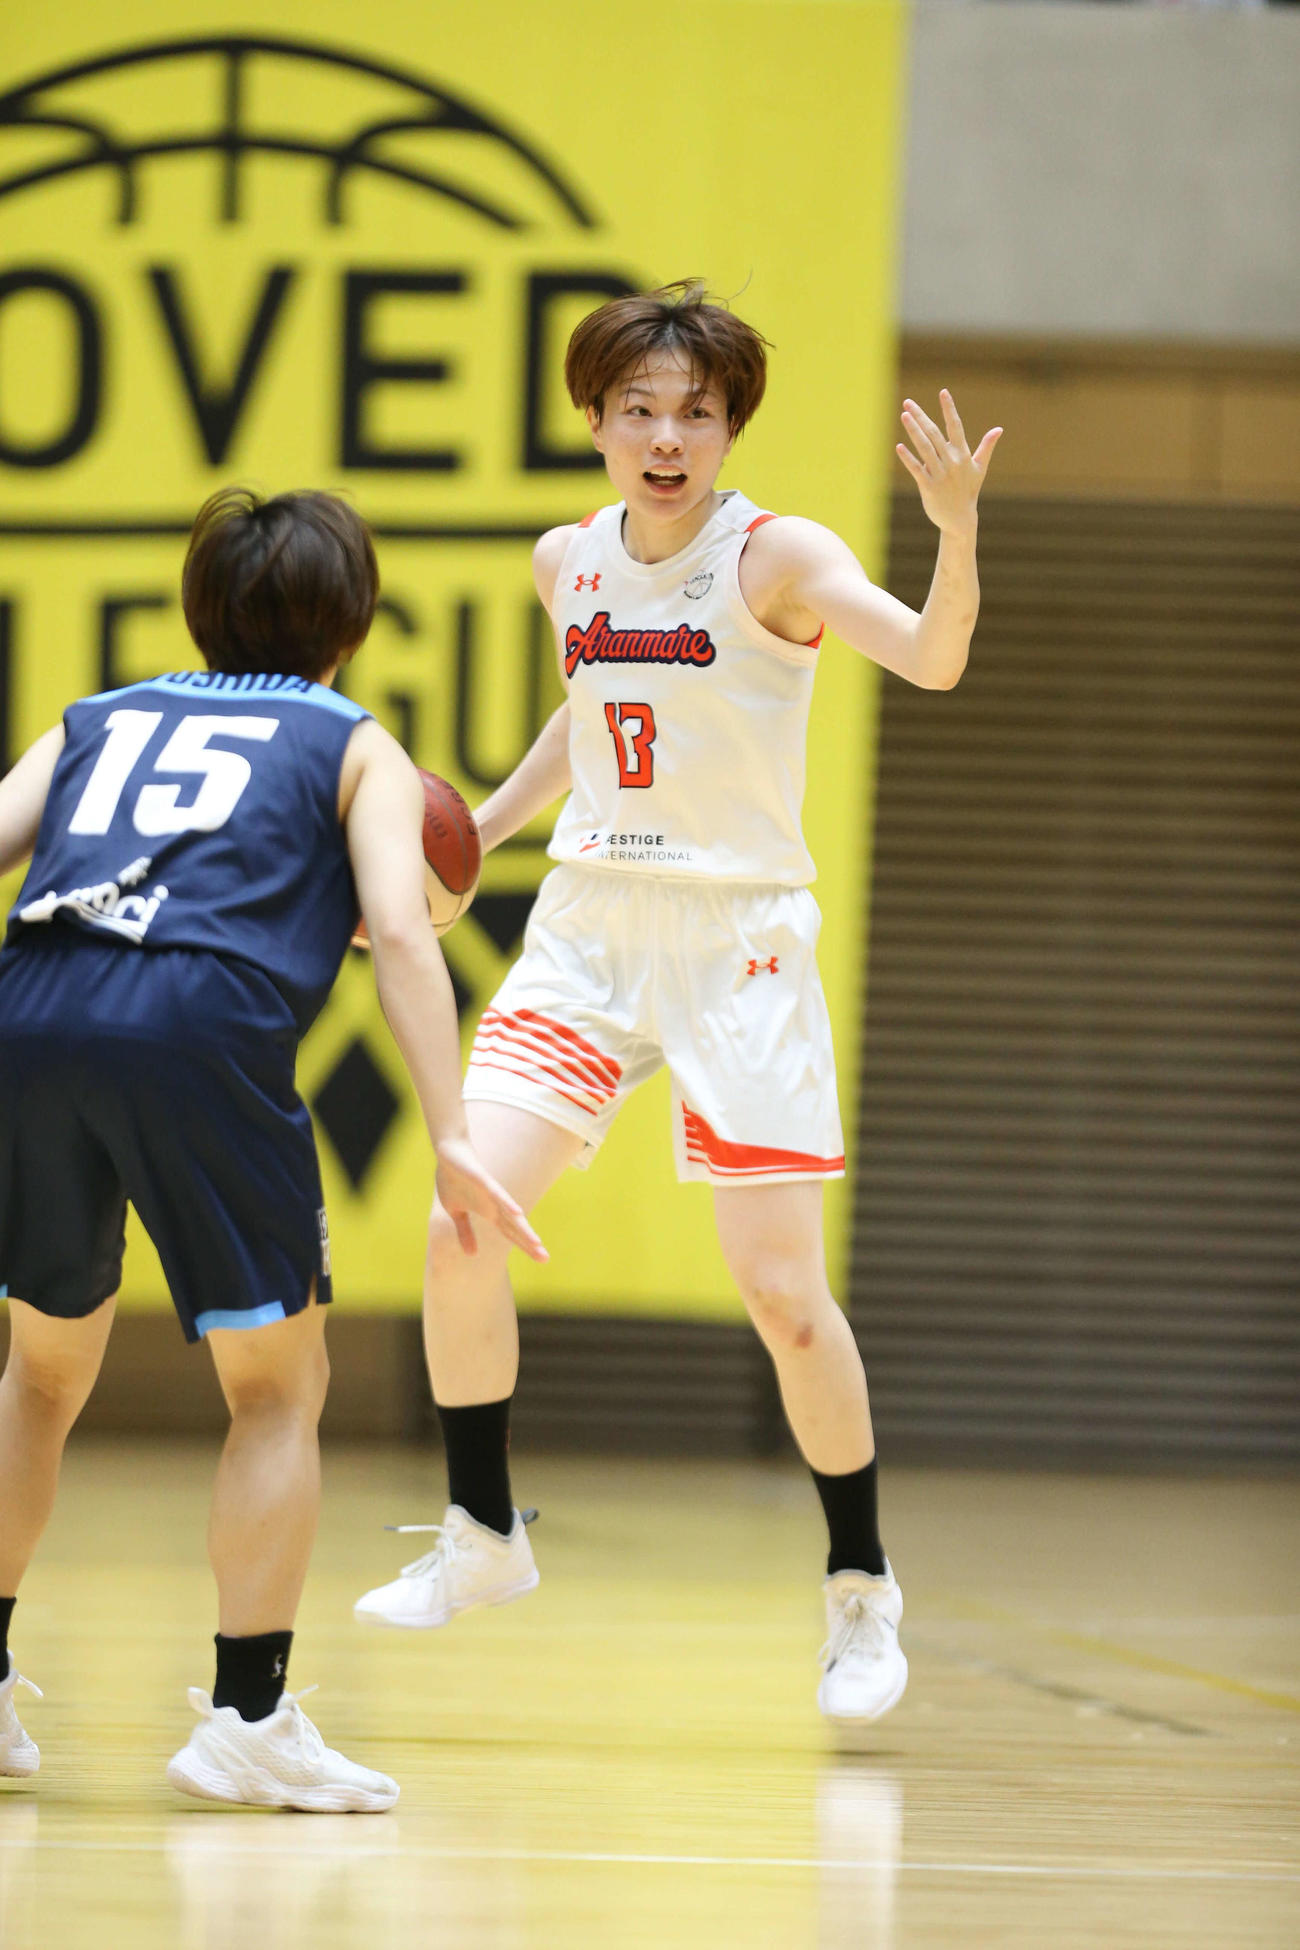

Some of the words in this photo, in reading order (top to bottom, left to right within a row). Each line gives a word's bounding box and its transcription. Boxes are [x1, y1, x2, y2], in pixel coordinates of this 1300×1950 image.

[565, 611, 716, 679] Aranmare
[68, 709, 279, 837] 15
[604, 702, 656, 789] 13
[598, 850, 693, 861] ERNATIONAL
[606, 834, 665, 846] ESTIGE
